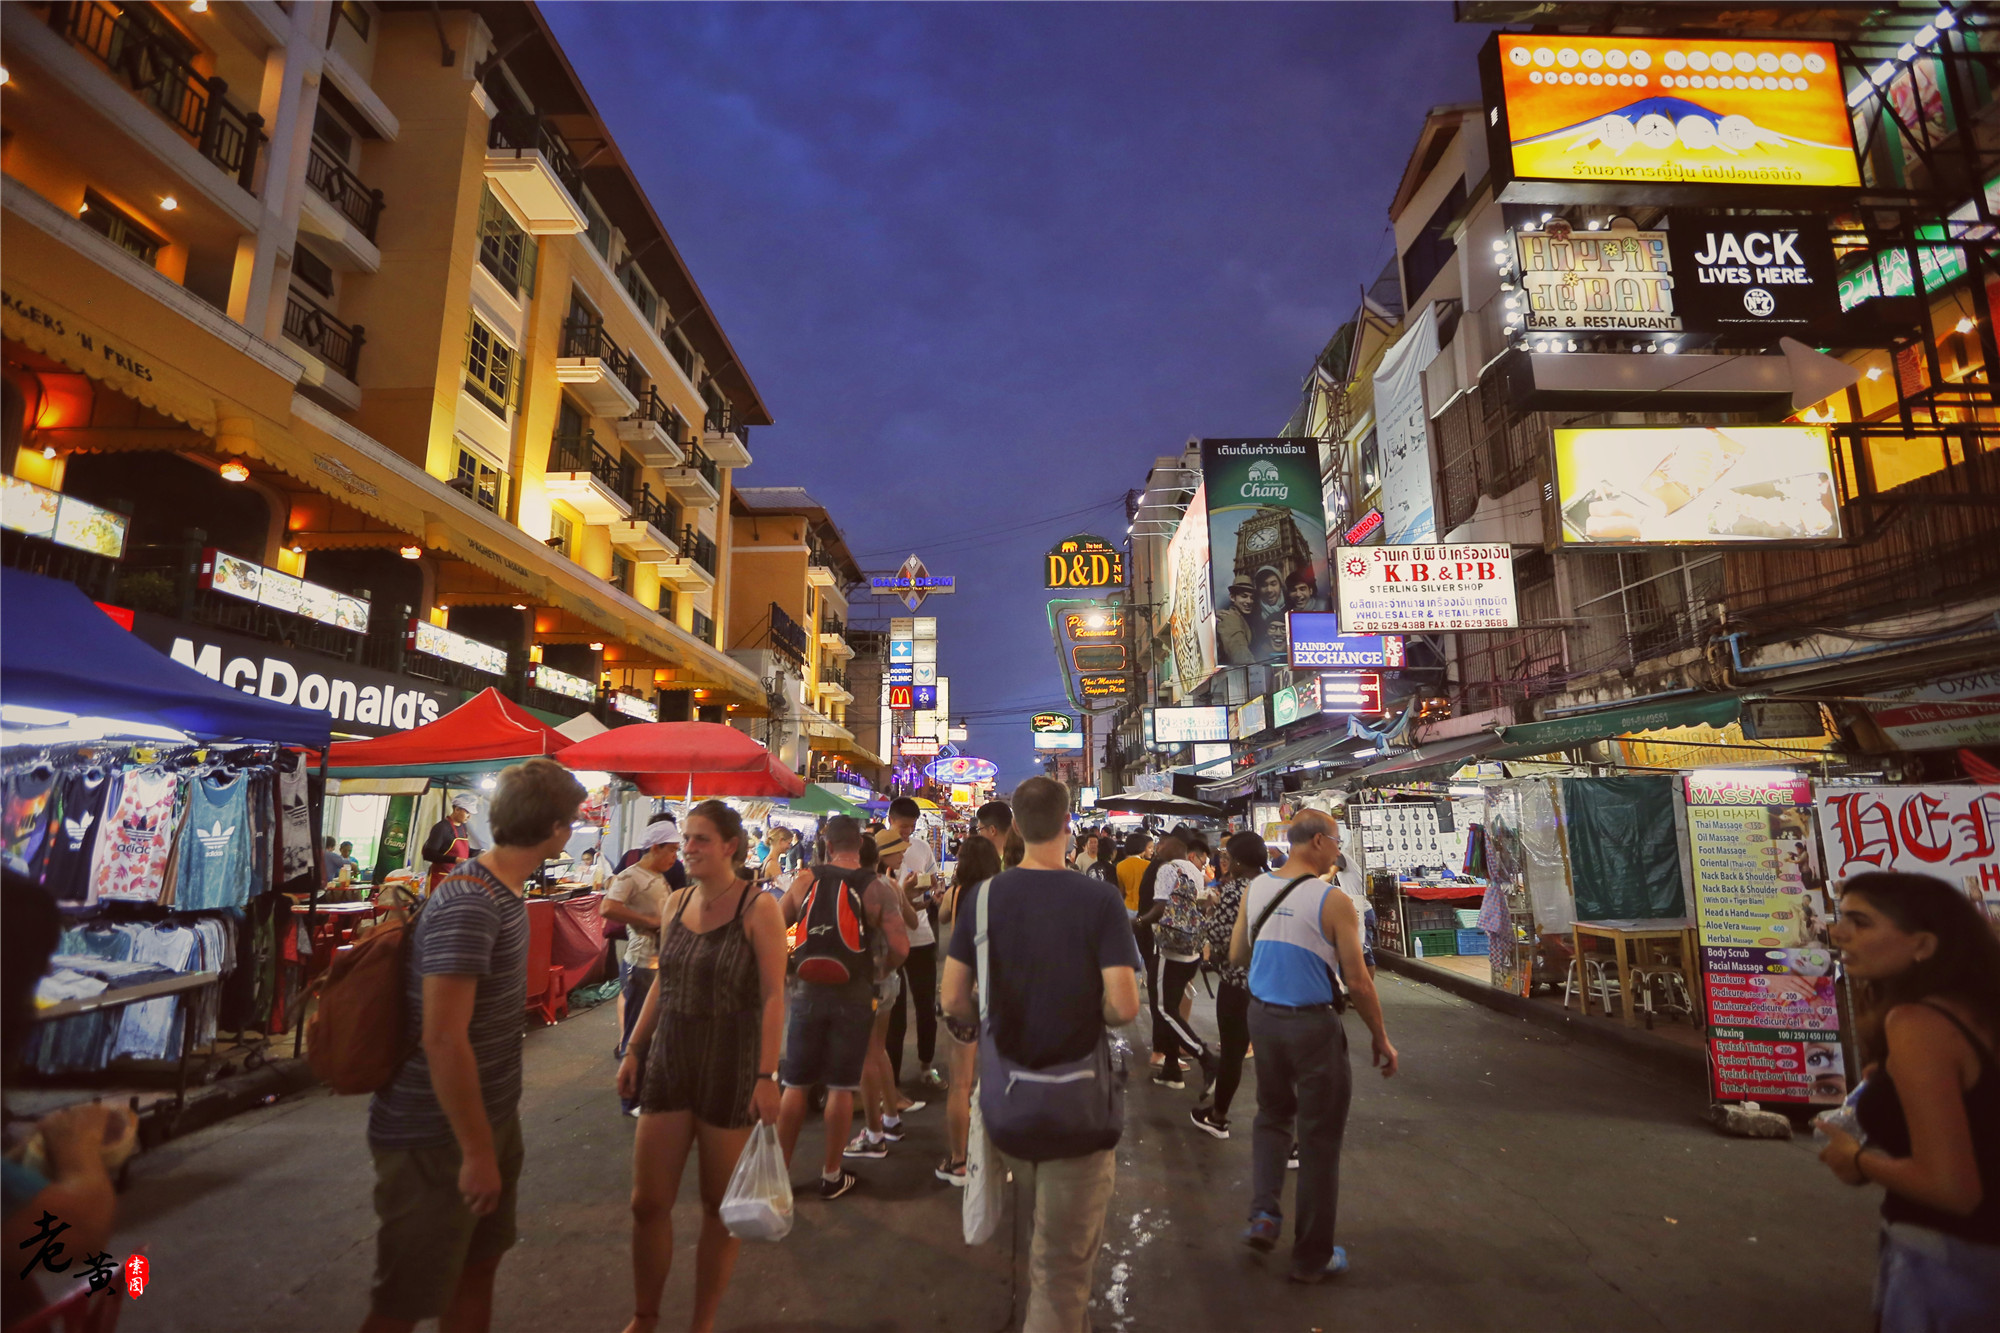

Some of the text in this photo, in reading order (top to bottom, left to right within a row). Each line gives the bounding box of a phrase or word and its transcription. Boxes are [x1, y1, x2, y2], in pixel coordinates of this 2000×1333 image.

[1694, 232, 1804, 266] JACK
[1698, 267, 1814, 284] LIVES HERE.
[1528, 315, 1677, 329] BAR & RESTAURANT
[103, 344, 153, 382] FRIES
[1217, 441, 1306, 456] เติมเต็มคำว่าเพื่อน
[1240, 482, 1289, 500] Chang
[1347, 513, 1381, 544] BAMBOO
[1048, 554, 1110, 587] D&D
[1113, 554, 1122, 584] INN
[1384, 563, 1436, 583] K.B.
[1439, 566, 1453, 580] &
[1455, 561, 1502, 581] P.B.
[873, 576, 953, 588] DANG DERM
[1370, 583, 1484, 594] STERLING SILVER SHOP
[1356, 608, 1502, 620] WHOLESALER & RETAIL PRICE
[1294, 642, 1344, 651] RAINBOW
[1294, 652, 1382, 665] EXCHANGE
[169, 637, 440, 730] McDonald's
[1905, 708, 1937, 721] The
[1896, 727, 1930, 739] When
[1690, 788, 1795, 805] MASSAGE
[1694, 809, 1760, 820] 타이 마사지
[1696, 820, 1712, 829] Thai
[1713, 821, 1743, 831] Massage
[384, 837, 406, 850] Chang
[1697, 833, 1708, 842] Oil
[1709, 834, 1740, 844] Massage
[1699, 846, 1715, 855] Foot
[1716, 846, 1747, 857] Massage
[1700, 858, 1729, 867] Oriental
[1730, 861, 1757, 869] (Thai+Oil)
[1701, 871, 1719, 880] Nack
[1720, 871, 1738, 880] Back
[1738, 872, 1744, 880] &
[1745, 872, 1776, 881] Shoulder
[1702, 885, 1720, 893] Nack
[1721, 885, 1738, 894] Back
[1739, 885, 1745, 893] &
[1747, 885, 1778, 894] Shoulder
[1734, 898, 1748, 906] Tiger
[1705, 908, 1724, 917] Head
[1730, 909, 1749, 917] Hand
[1706, 921, 1722, 930] Aloe
[1723, 922, 1740, 930] Vera
[1707, 934, 1732, 943] Herbal
[1707, 948, 1749, 959] Body Scrub
[1709, 961, 1731, 970] Facial
[1732, 962, 1763, 973] Massage
[1710, 974, 1765, 986] Manicure 150
[1711, 987, 1745, 998] Pedicure
[1713, 1001, 1747, 1011] Manicure
[1752, 1003, 1782, 1012] Pedicure
[1714, 1014, 1749, 1025] Manicure
[1755, 1017, 1786, 1026] Pedicure
[1787, 1017, 1801, 1027] Gel
[1808, 1020, 1820, 1028] 600
[1715, 1027, 1744, 1039] Waxing
[1778, 1031, 1789, 1039] 100
[1717, 1041, 1745, 1053] Eyelash
[1746, 1042, 1774, 1055] Tinting
[1718, 1055, 1747, 1067] Eyebow
[1748, 1056, 1775, 1069] Tinting
[1719, 1068, 1748, 1080] Eyelash
[1754, 1071, 1782, 1082] Eyebow
[1784, 1072, 1798, 1081] Tint
[1721, 1082, 1749, 1095] Eyelash
